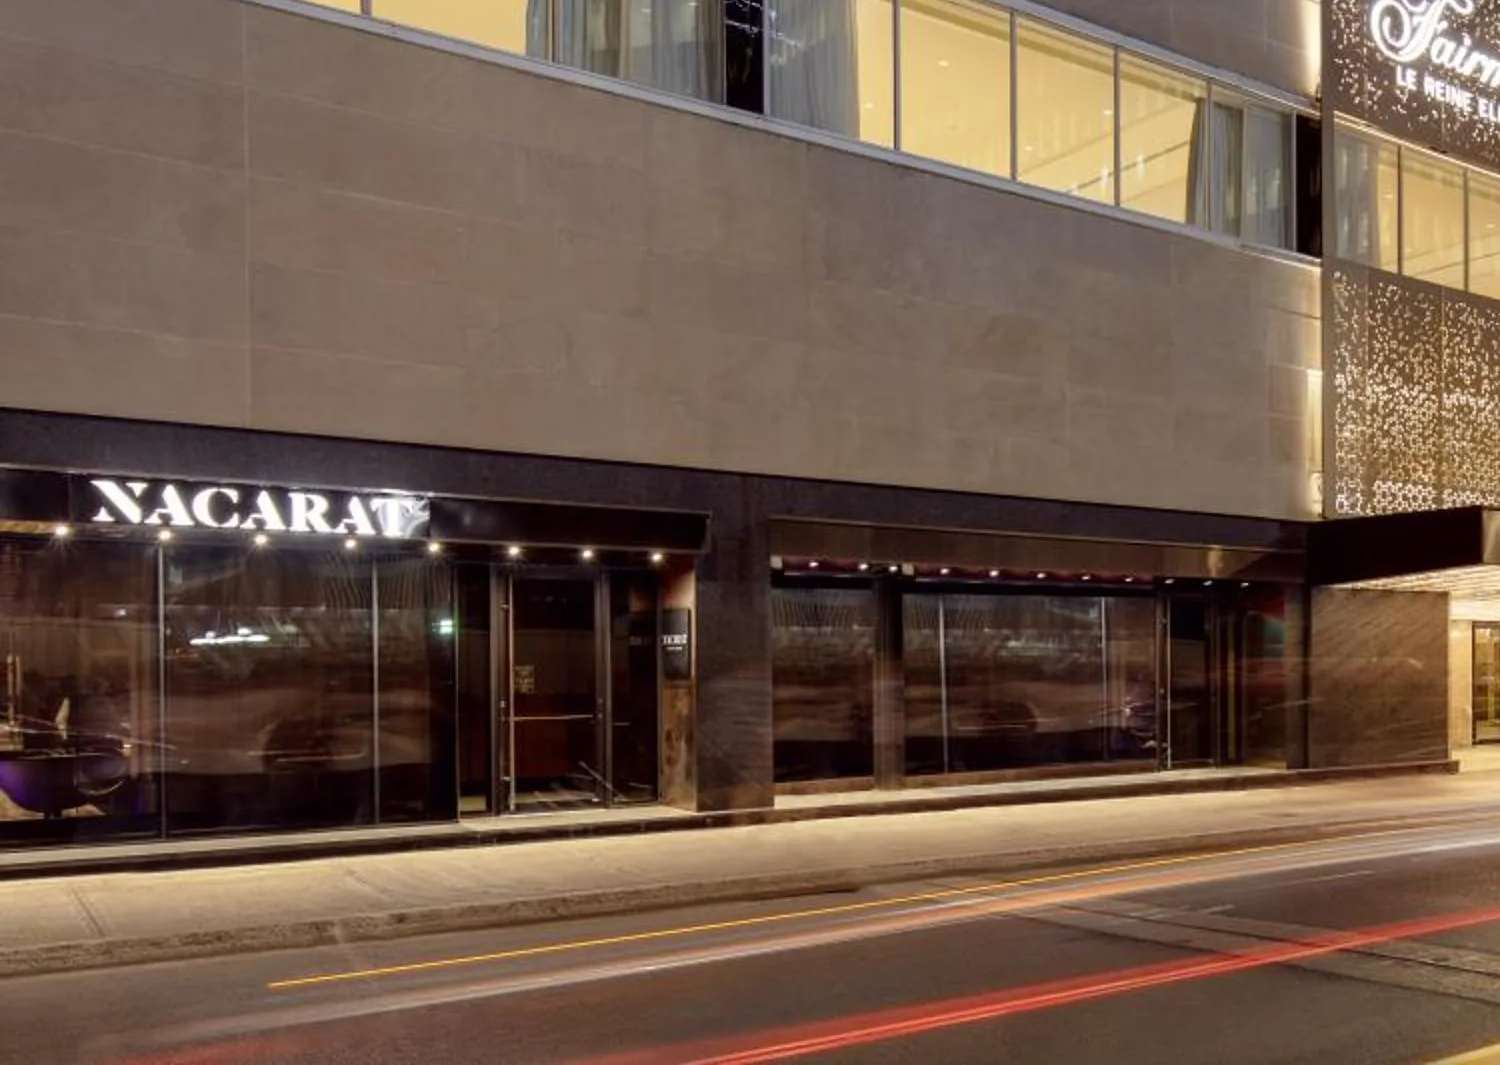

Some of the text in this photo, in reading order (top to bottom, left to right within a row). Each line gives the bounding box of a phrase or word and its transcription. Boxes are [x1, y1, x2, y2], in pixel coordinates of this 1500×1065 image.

[1395, 65, 1418, 92] LE
[1423, 72, 1474, 113] REINE
[90, 479, 417, 538] NACARAT
